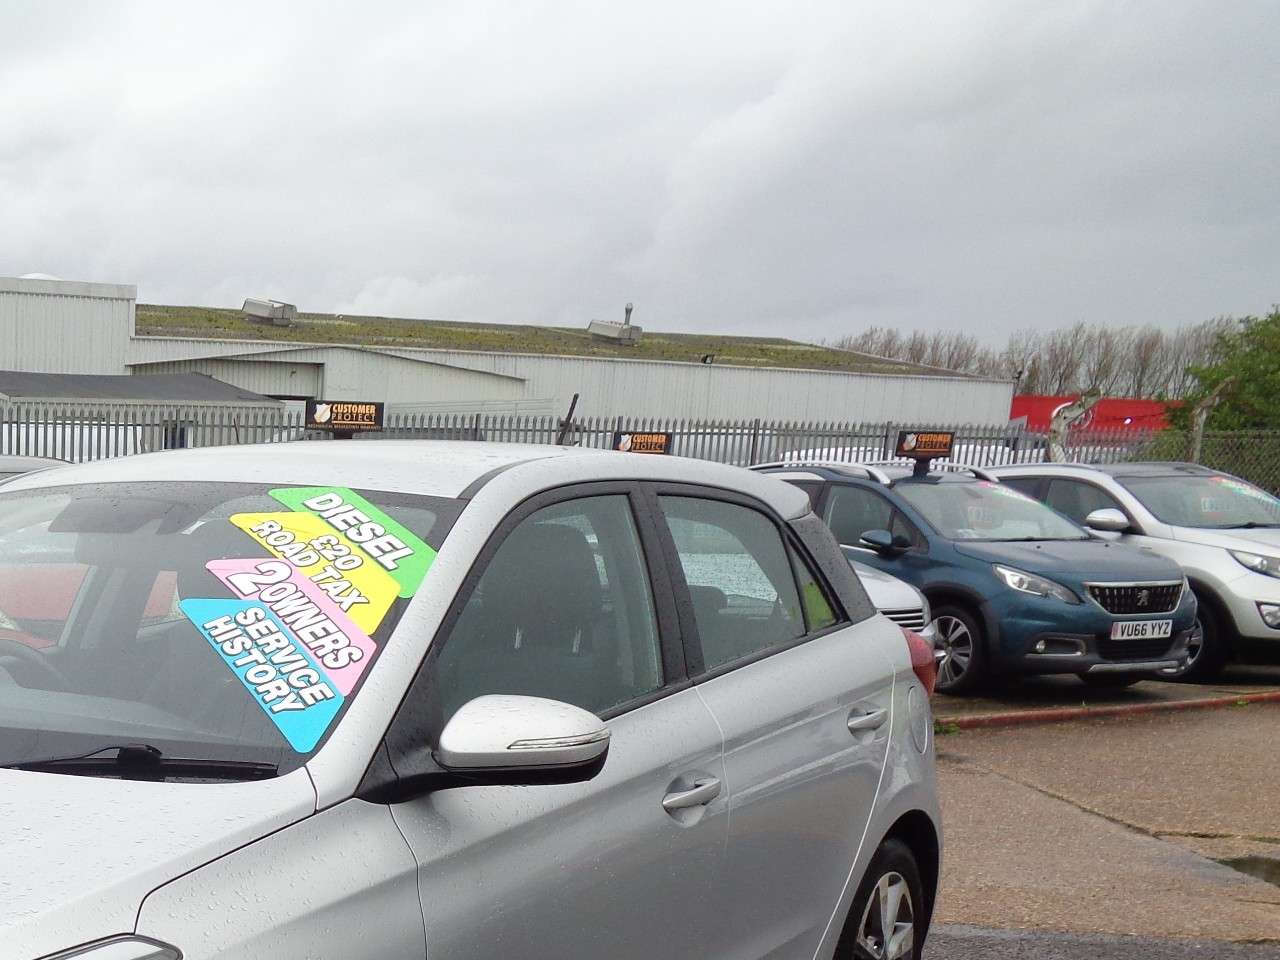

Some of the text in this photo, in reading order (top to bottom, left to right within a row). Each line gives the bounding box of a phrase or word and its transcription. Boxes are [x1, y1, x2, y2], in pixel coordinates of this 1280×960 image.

[331, 413, 376, 422] PROTECT
[333, 403, 376, 414] CUSTOMER
[632, 434, 666, 443] CUSTOMER
[303, 492, 415, 571] DIESEL
[249, 520, 370, 613] ROAD TAX
[308, 534, 364, 571] £20
[1121, 622, 1171, 637] VU66 YYZ
[202, 615, 306, 714] HISTORY
[233, 607, 337, 706] SERVICE
